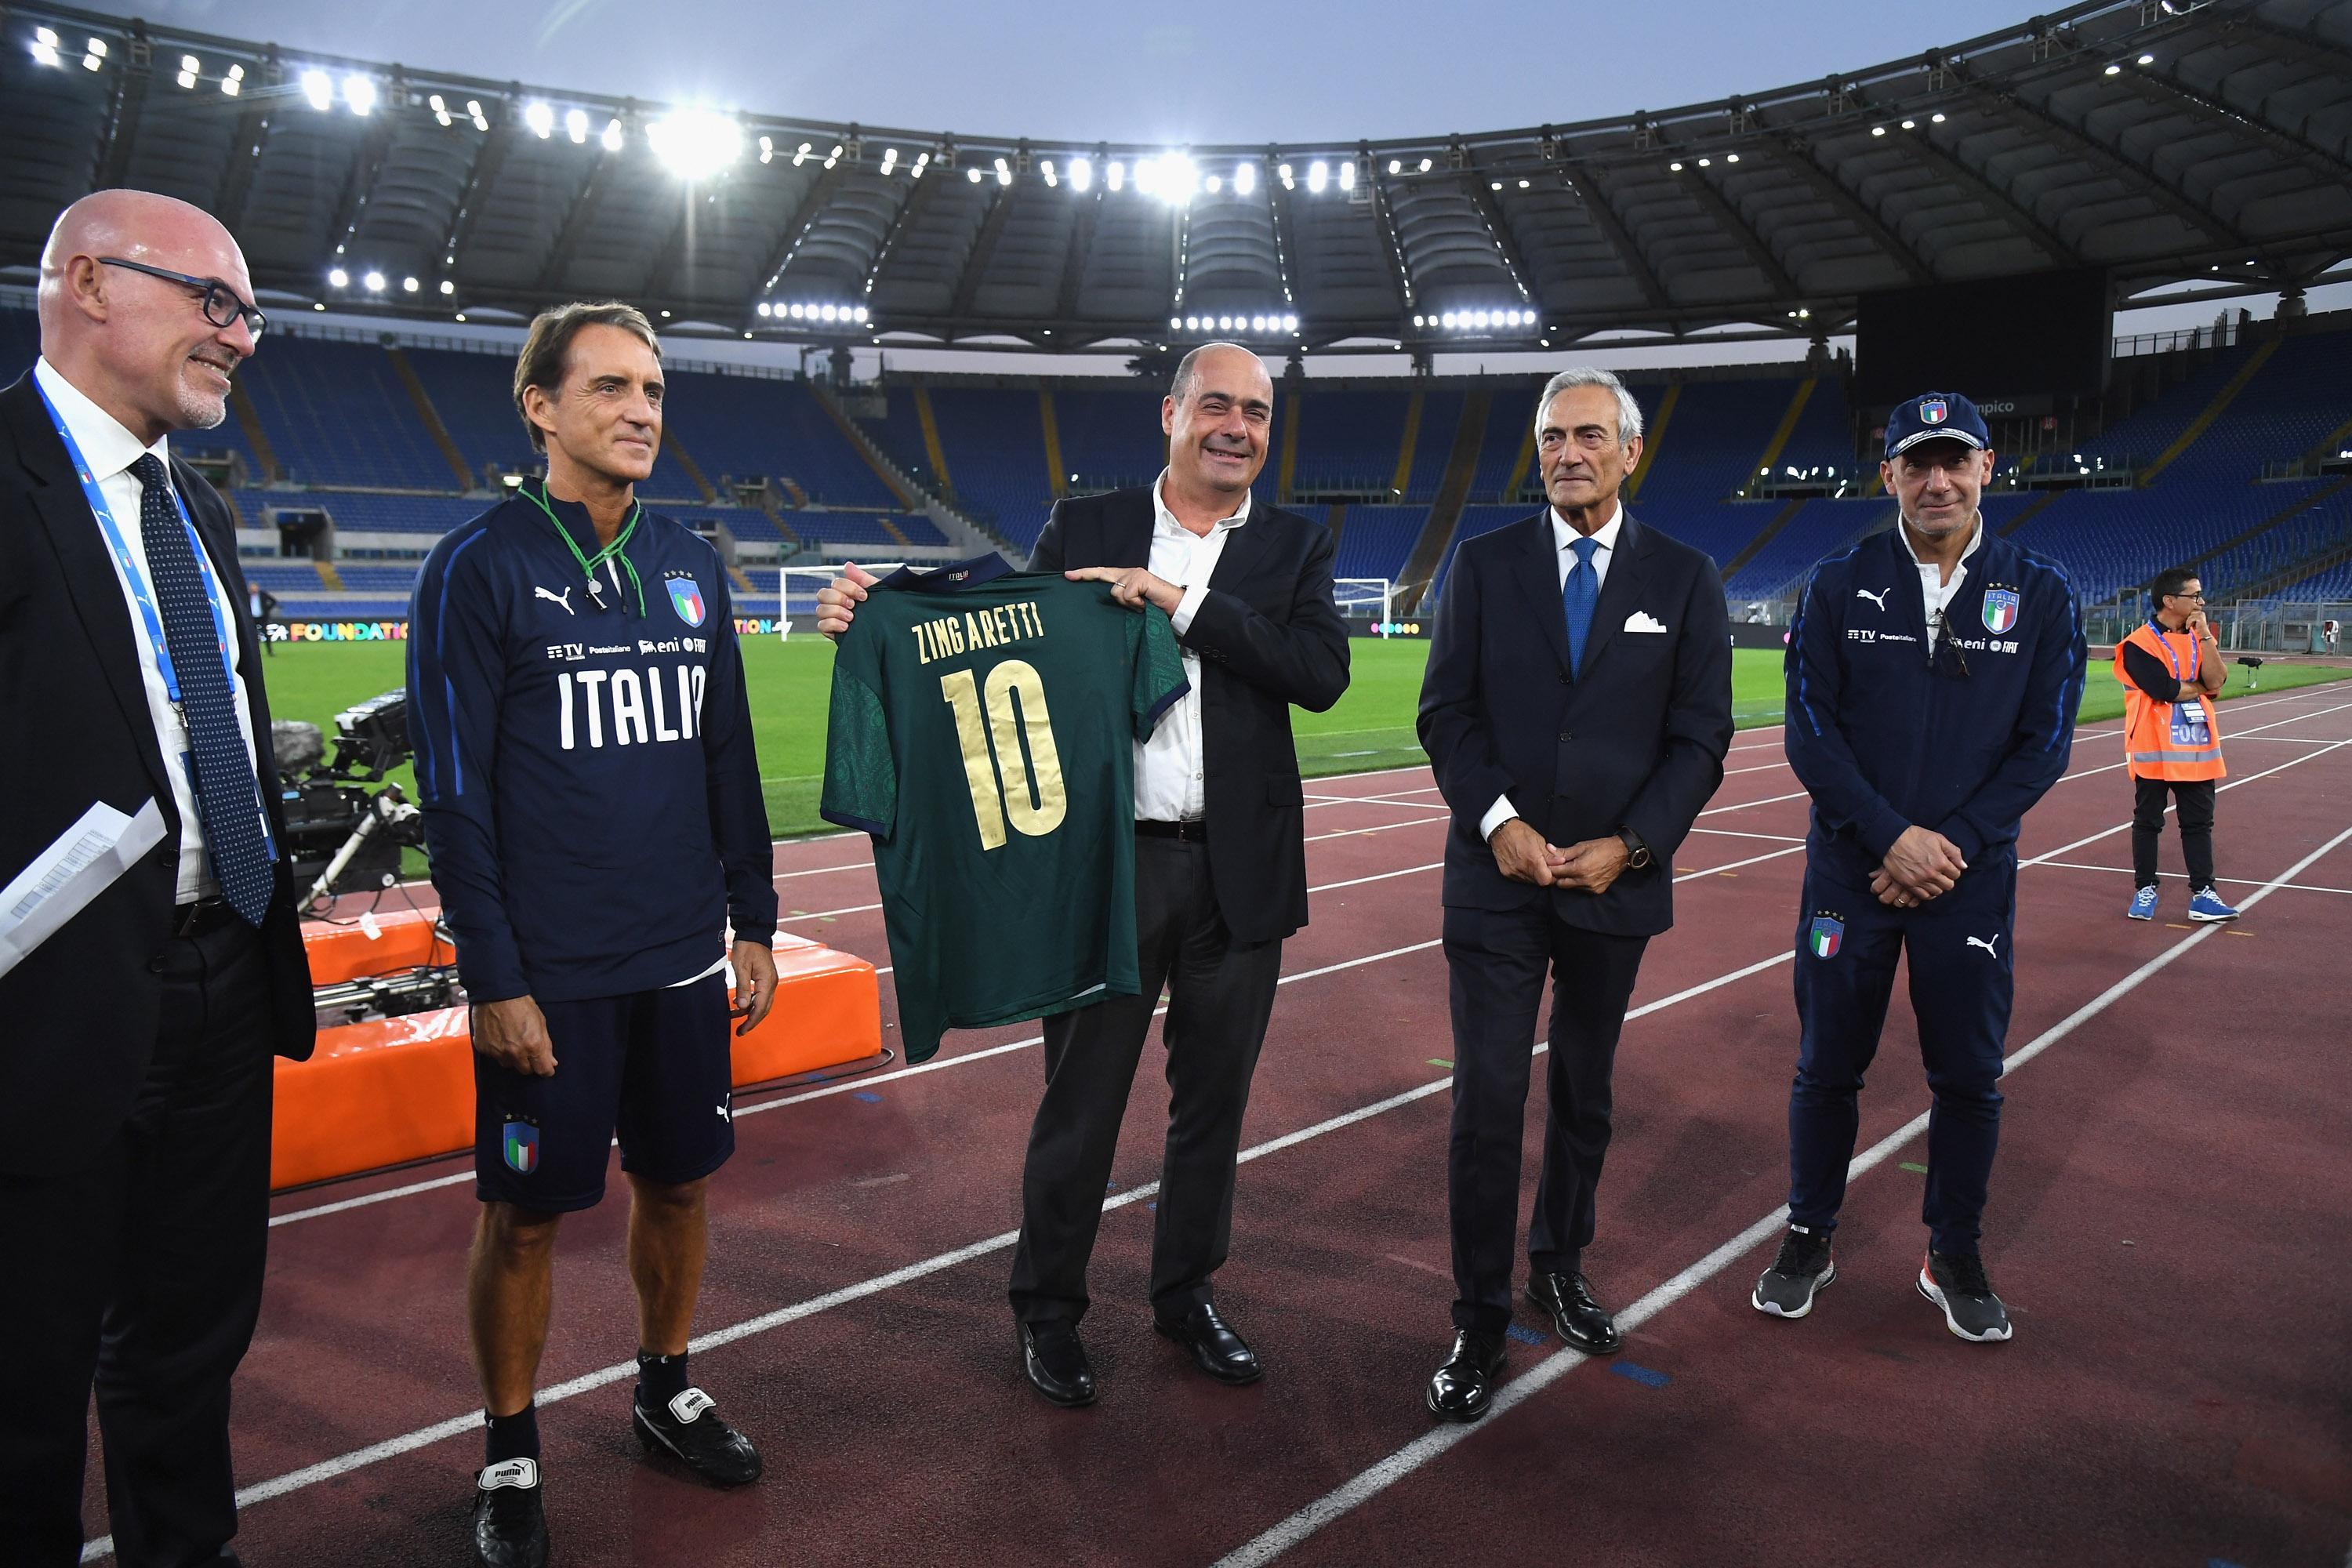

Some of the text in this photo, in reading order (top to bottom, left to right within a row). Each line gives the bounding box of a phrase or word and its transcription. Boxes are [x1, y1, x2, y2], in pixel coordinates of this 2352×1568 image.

[1988, 593, 2016, 602] ITALIA
[911, 601, 1044, 665] ZINGARETTI
[1860, 630, 1876, 640] TV
[1964, 637, 1986, 650] eni
[2002, 641, 2019, 654] FIAT
[563, 643, 583, 656] TV
[657, 637, 680, 653] eni
[940, 659, 1067, 851] 10
[495, 1468, 521, 1478] PUMA
